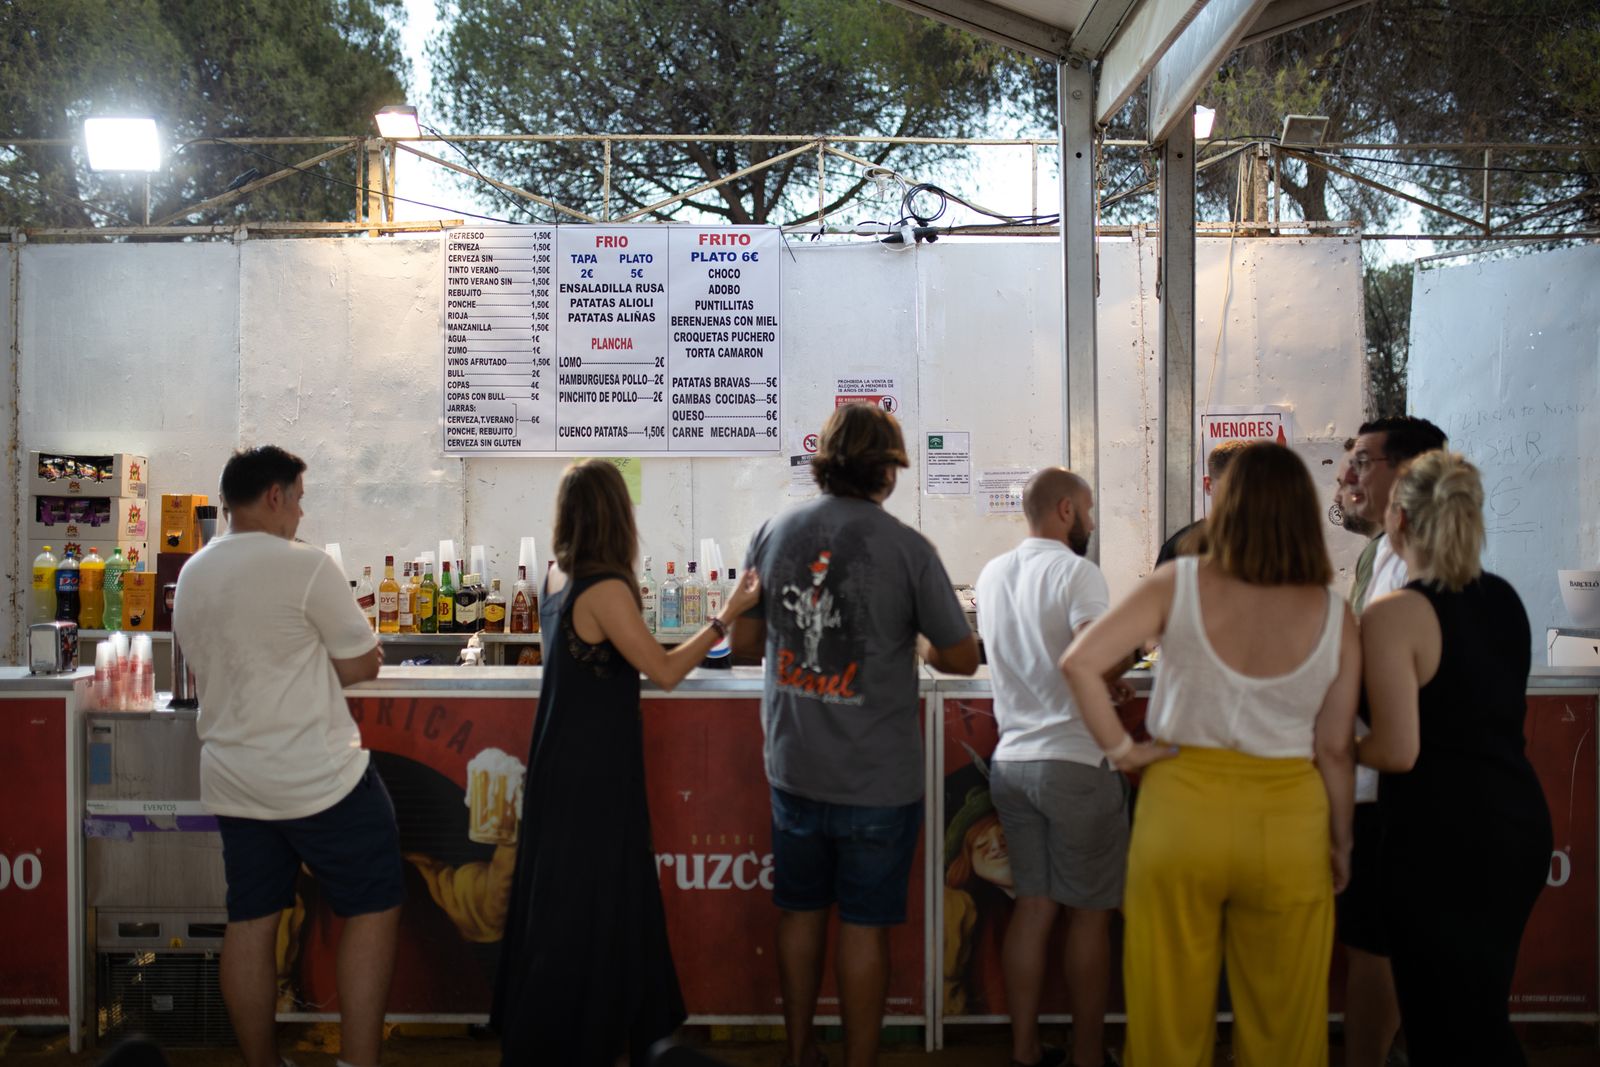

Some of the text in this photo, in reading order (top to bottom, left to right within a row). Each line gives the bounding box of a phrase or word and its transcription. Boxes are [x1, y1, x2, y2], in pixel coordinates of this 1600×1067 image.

[596, 236, 628, 248] FRIO
[699, 234, 751, 245] FRITO
[532, 255, 550, 263] 1,50€
[571, 254, 653, 263] TAPA PLATO
[691, 252, 759, 262] PLATO 6€
[581, 269, 643, 278] 2€ 5€
[708, 268, 740, 278] CHOCO
[531, 278, 550, 286] 1,50€
[531, 289, 550, 298] 1,50€
[560, 284, 664, 293] ENSALADILLA RUSA
[708, 285, 740, 294] ADOBO
[531, 301, 549, 309] 1,50€
[570, 298, 653, 307] PATATAS ALIOLI
[695, 300, 754, 310] PUNTILLITAS
[531, 312, 549, 320] 1,50€
[568, 311, 656, 322] PATATAS ALIÑAS
[671, 316, 778, 326] BERENJENAS CON MIEL
[531, 324, 549, 332] 1,50€
[674, 332, 775, 342] CROQUETAS PUCHERO
[591, 338, 633, 349] PLANCHA
[686, 348, 763, 358] TORTA CAMARON
[559, 357, 664, 368] LOMO 2€
[559, 374, 664, 385] HAMBURGUESA POLLO 2€
[672, 377, 777, 388] PATATAS BRAVAS 5€
[559, 392, 663, 402] PINCHITO DE POLLO 2€
[672, 394, 777, 404] GAMBAS COCIDAS 5€
[672, 410, 777, 421] QUESO 6€
[559, 427, 665, 439] CUENCO PATATAS 1,50€
[672, 427, 778, 437] CARNE MECHADA 6€
[1210, 422, 1273, 438] MENORES
